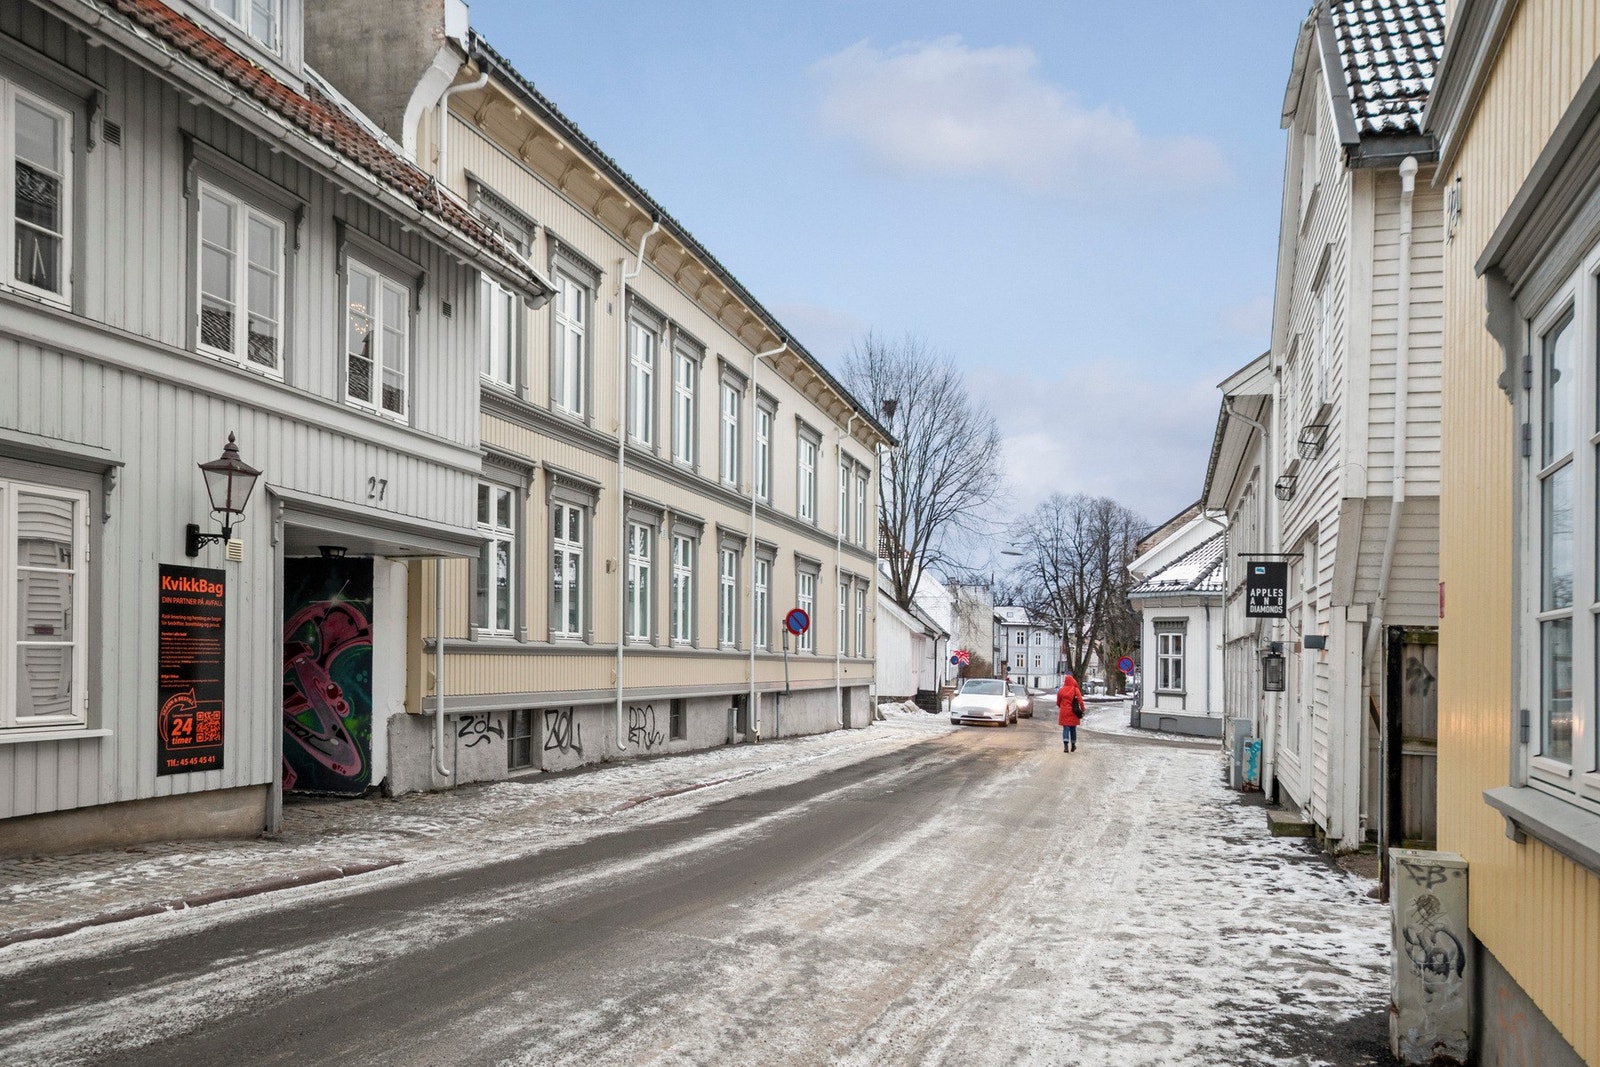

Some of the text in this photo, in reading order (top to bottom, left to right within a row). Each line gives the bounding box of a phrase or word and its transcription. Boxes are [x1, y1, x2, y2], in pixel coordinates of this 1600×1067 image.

[368, 476, 388, 501] 27
[162, 576, 224, 598] KvikkBag
[1250, 588, 1283, 597] APPLES
[172, 597, 196, 605] PARTNER
[198, 597, 204, 606] PÅ
[1250, 606, 1283, 614] DIAMONDS
[172, 718, 193, 736] 24
[172, 736, 192, 745] timer
[180, 758, 188, 766] 45
[199, 756, 207, 764] 45
